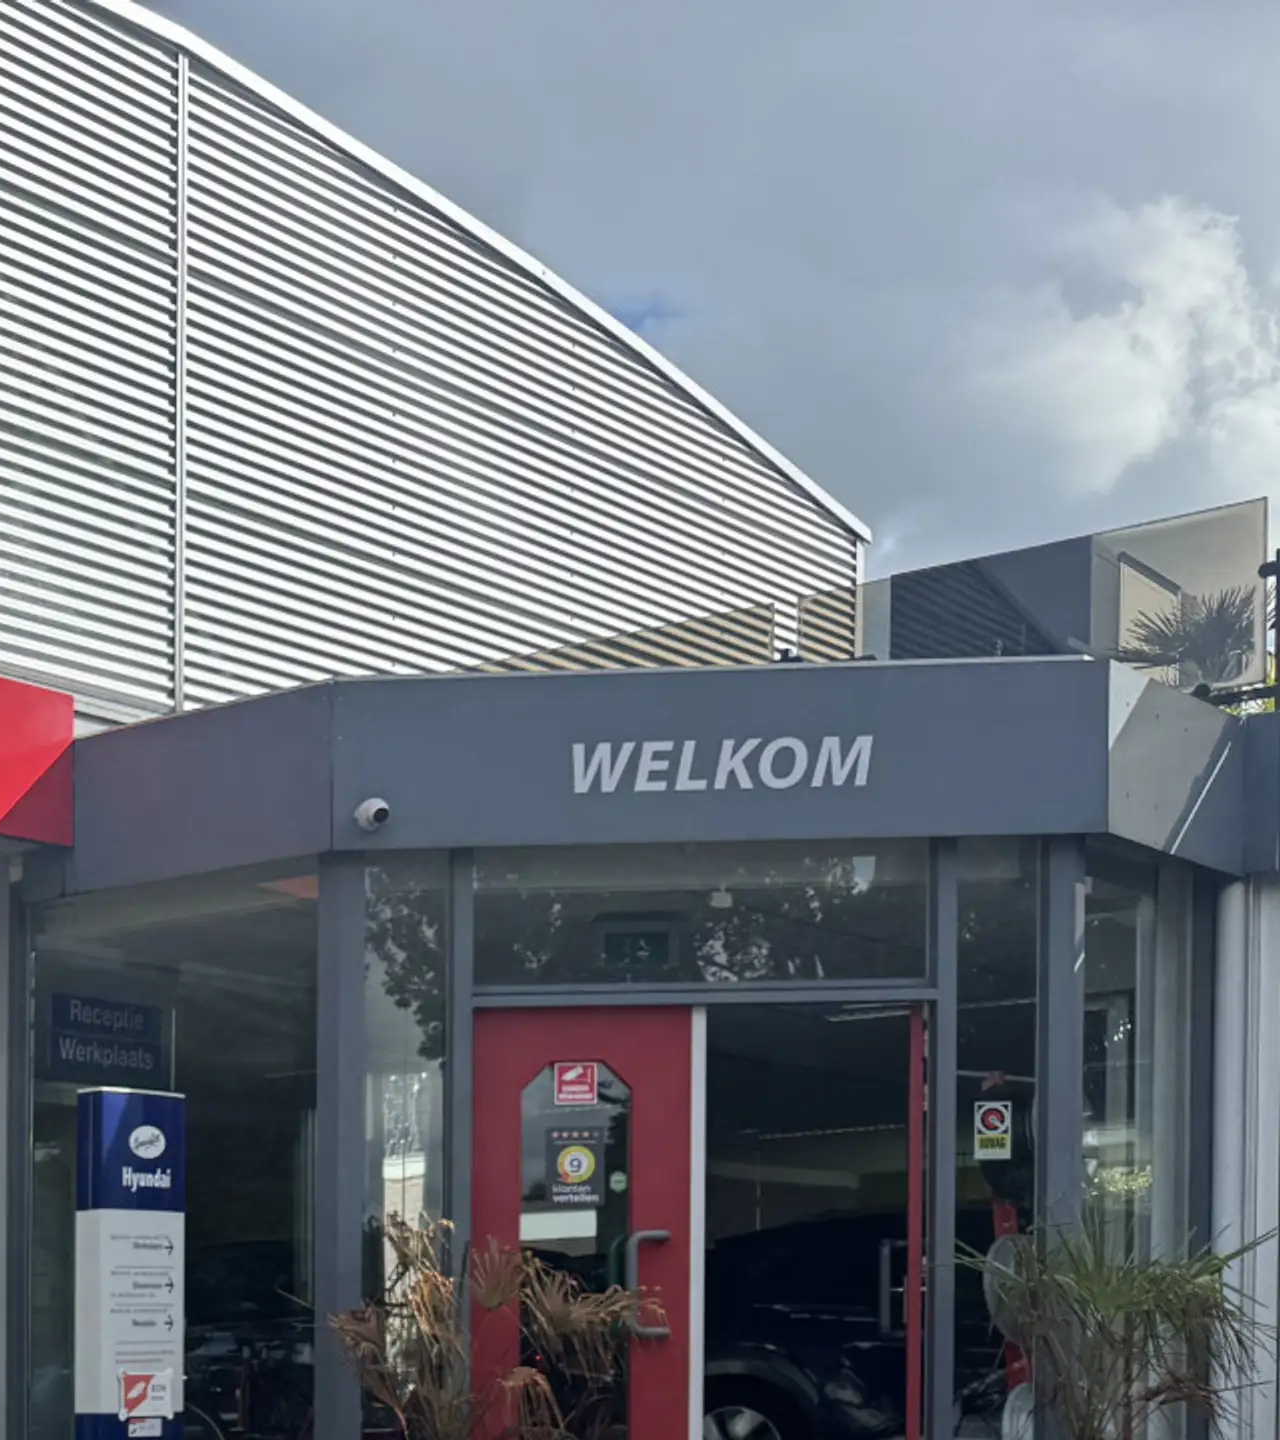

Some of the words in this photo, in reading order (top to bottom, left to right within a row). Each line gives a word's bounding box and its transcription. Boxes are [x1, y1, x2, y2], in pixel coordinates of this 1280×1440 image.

[572, 735, 873, 793] WELKOM
[69, 998, 145, 1032] Receptie
[58, 1035, 155, 1070] Werkplaats
[122, 1167, 172, 1192] Hyundai
